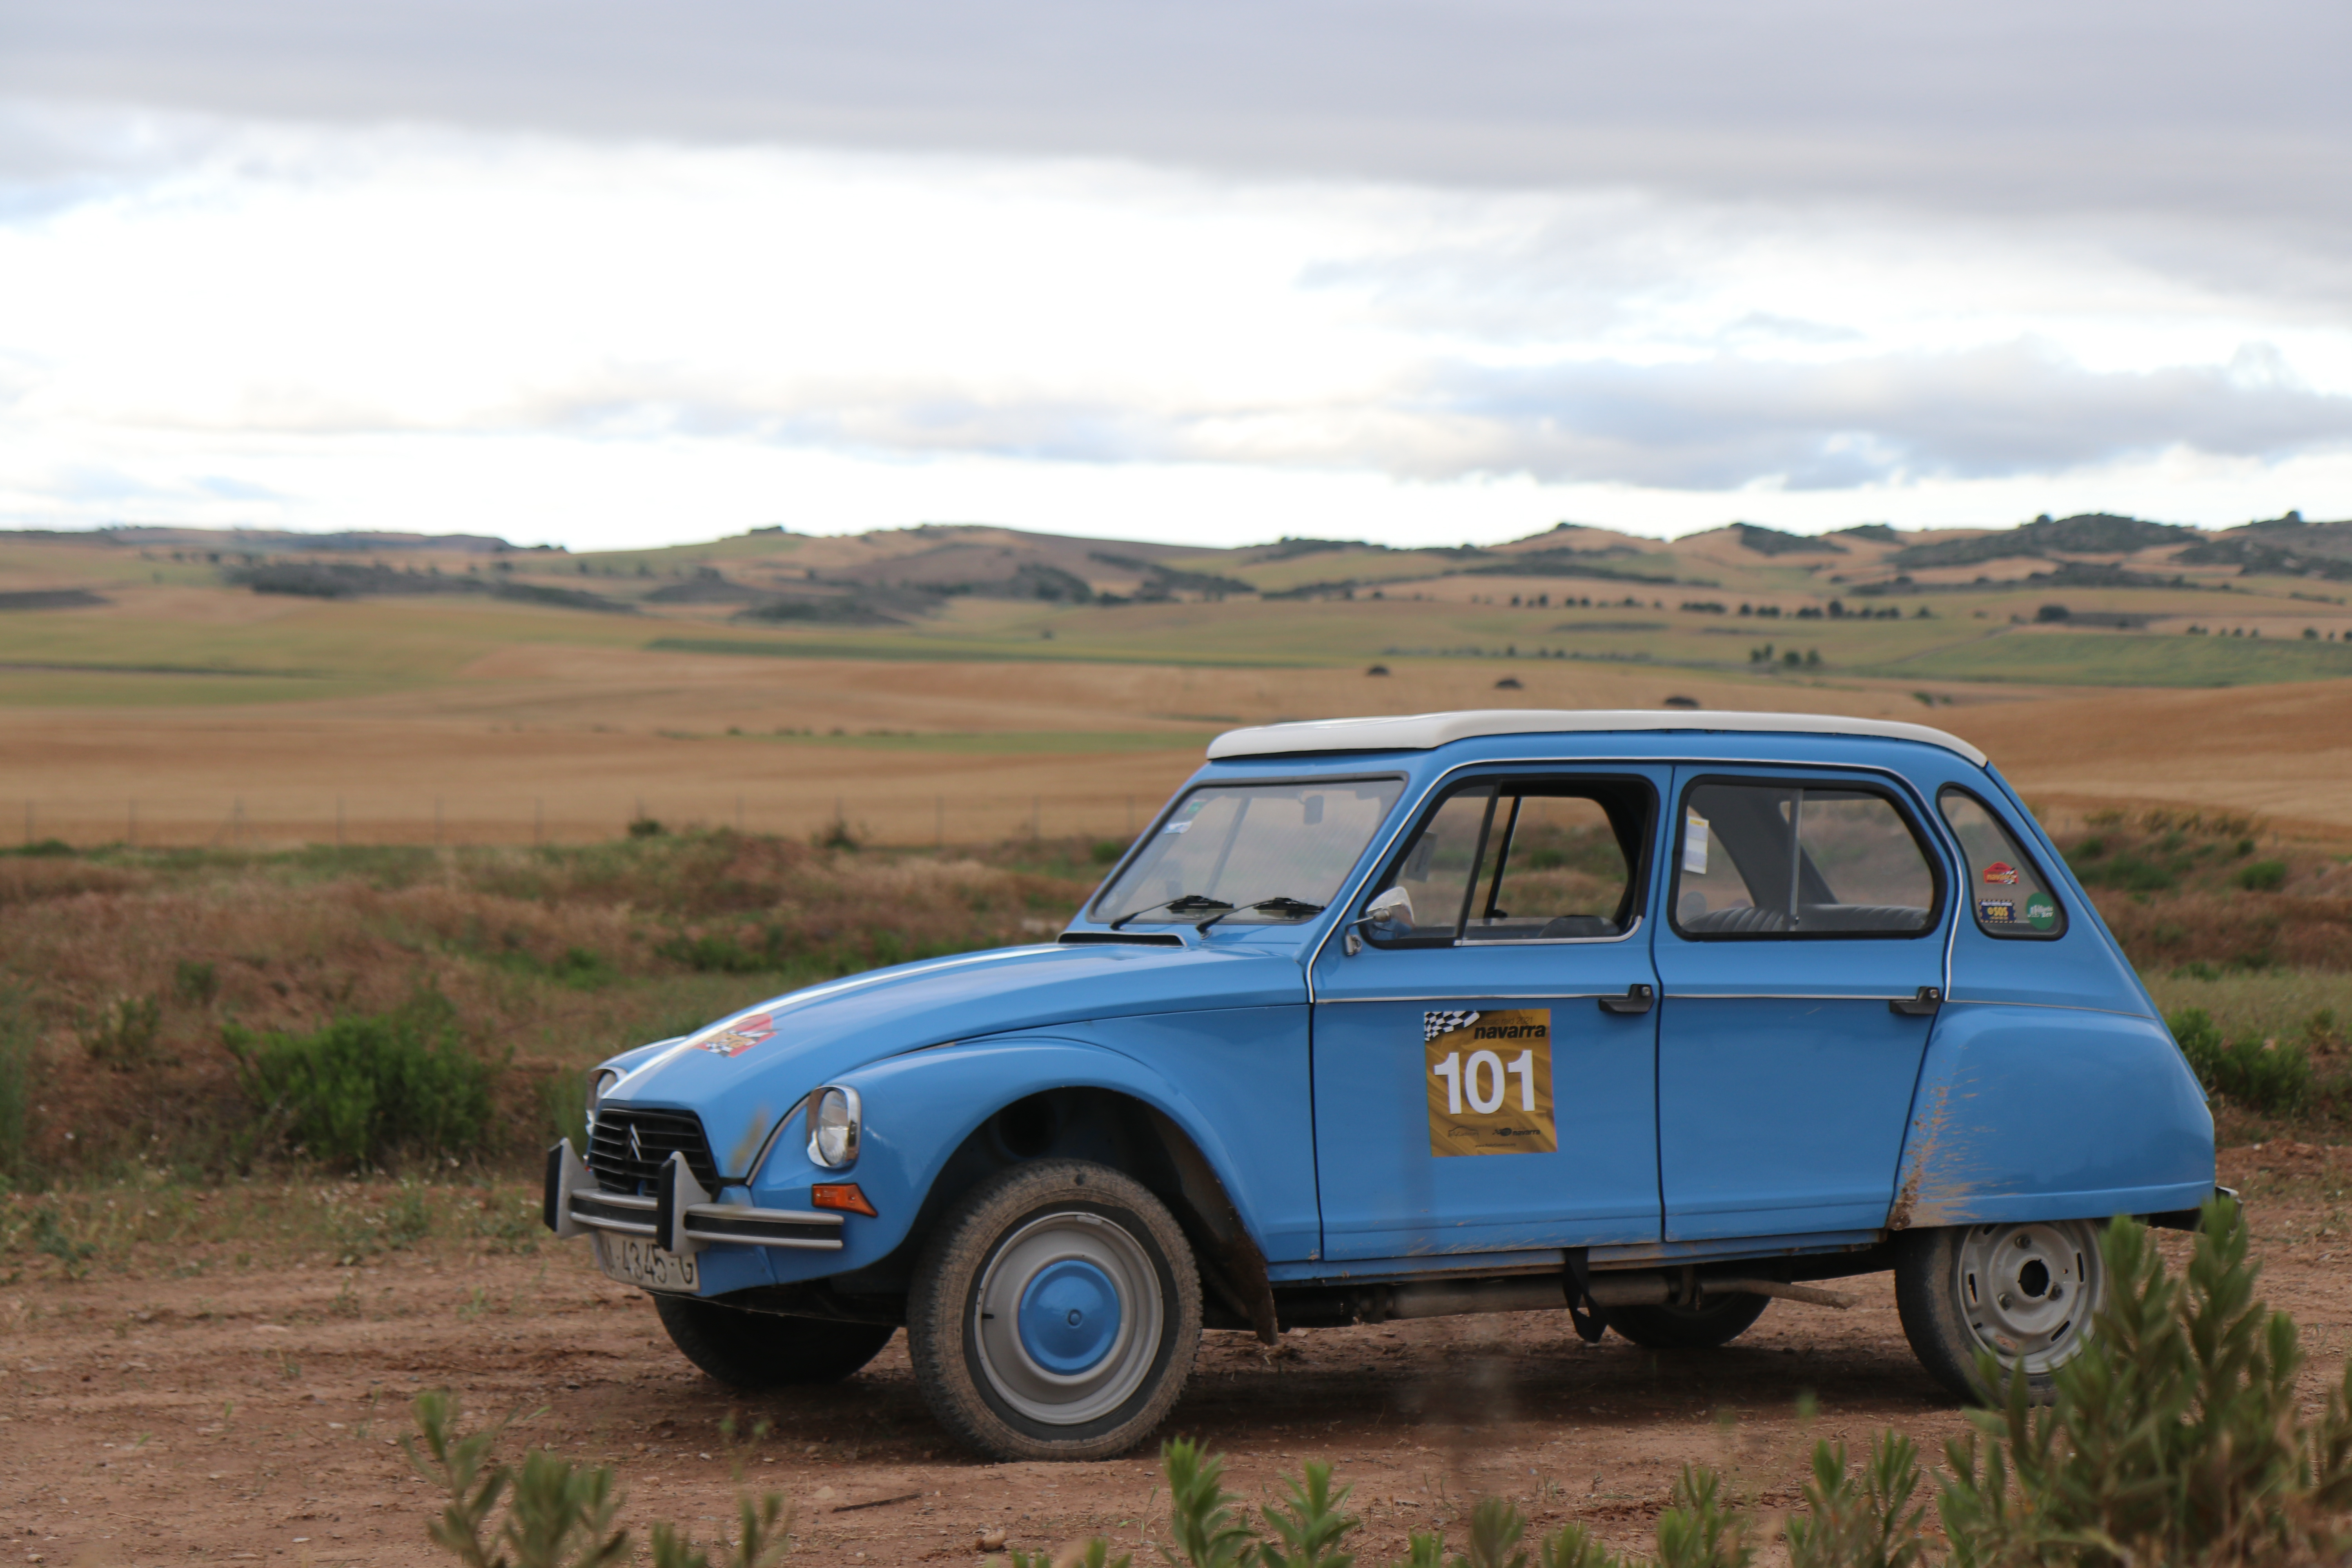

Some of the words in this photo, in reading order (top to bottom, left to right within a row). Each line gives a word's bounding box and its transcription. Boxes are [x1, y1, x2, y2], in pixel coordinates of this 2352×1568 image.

[1516, 1016, 1533, 1025] 2021
[1474, 1025, 1546, 1039] navarra
[1434, 1049, 1535, 1115] 101
